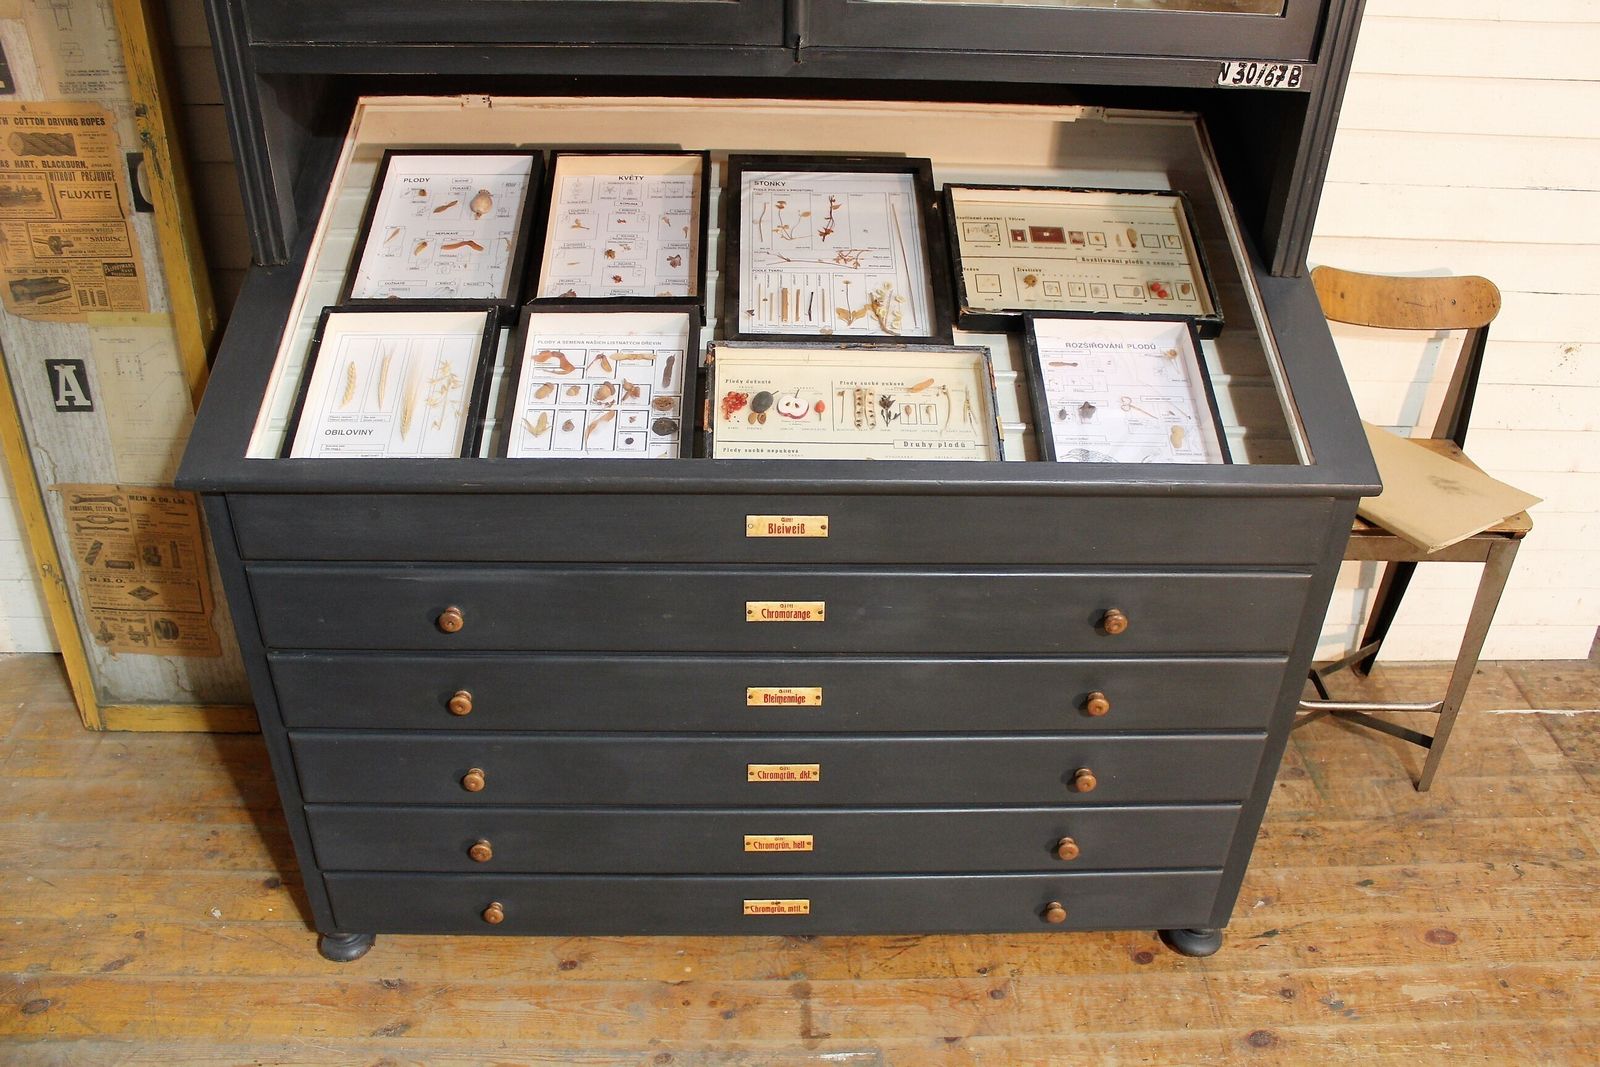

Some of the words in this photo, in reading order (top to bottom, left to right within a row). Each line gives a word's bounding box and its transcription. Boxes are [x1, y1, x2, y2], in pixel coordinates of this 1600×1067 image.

[14, 117, 46, 126] COTTON
[47, 117, 79, 126] DRIVING
[80, 117, 106, 126] ROPES
[42, 160, 89, 170] BLACKBURN,
[49, 171, 76, 182] WITHOUT
[81, 171, 116, 182] PREJUDICE
[59, 190, 112, 199] FLUXITE
[54, 365, 92, 407] A
[903, 441, 933, 449] Druhy
[938, 440, 967, 449] plodů
[768, 523, 805, 534] Bleiweiß
[761, 608, 811, 620] Chromorange
[763, 693, 806, 704] Bleimennige
[757, 770, 797, 780] Chromgrün,
[753, 841, 791, 850] Chromgrün,
[793, 841, 805, 849] hell
[750, 905, 787, 914] Chromgrün,
